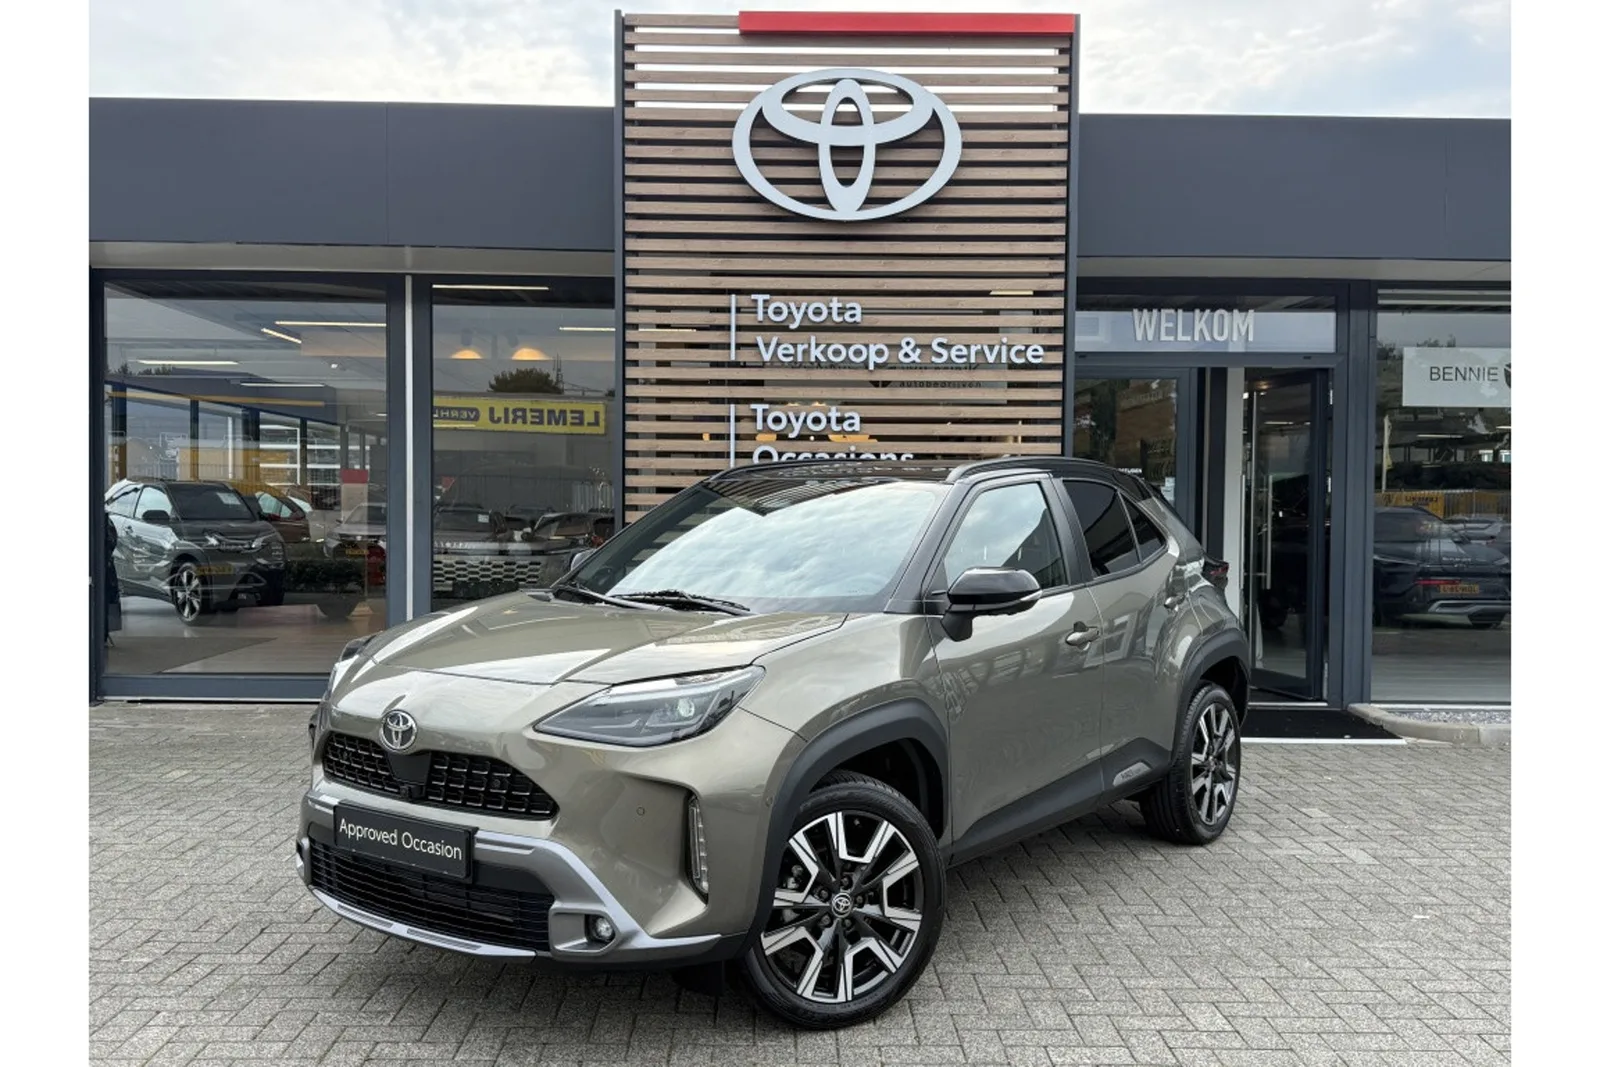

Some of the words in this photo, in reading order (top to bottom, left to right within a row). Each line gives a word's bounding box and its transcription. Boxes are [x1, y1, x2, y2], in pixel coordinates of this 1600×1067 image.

[751, 294, 862, 329] Toyota
[1132, 308, 1255, 341] WELKOM
[756, 335, 889, 370] Verkoop
[898, 336, 921, 363] &
[931, 336, 1044, 364] Service
[1429, 366, 1499, 381] BENNIE
[750, 404, 861, 438] Toyota
[339, 818, 398, 846] Approved
[401, 831, 462, 860] Occasion
